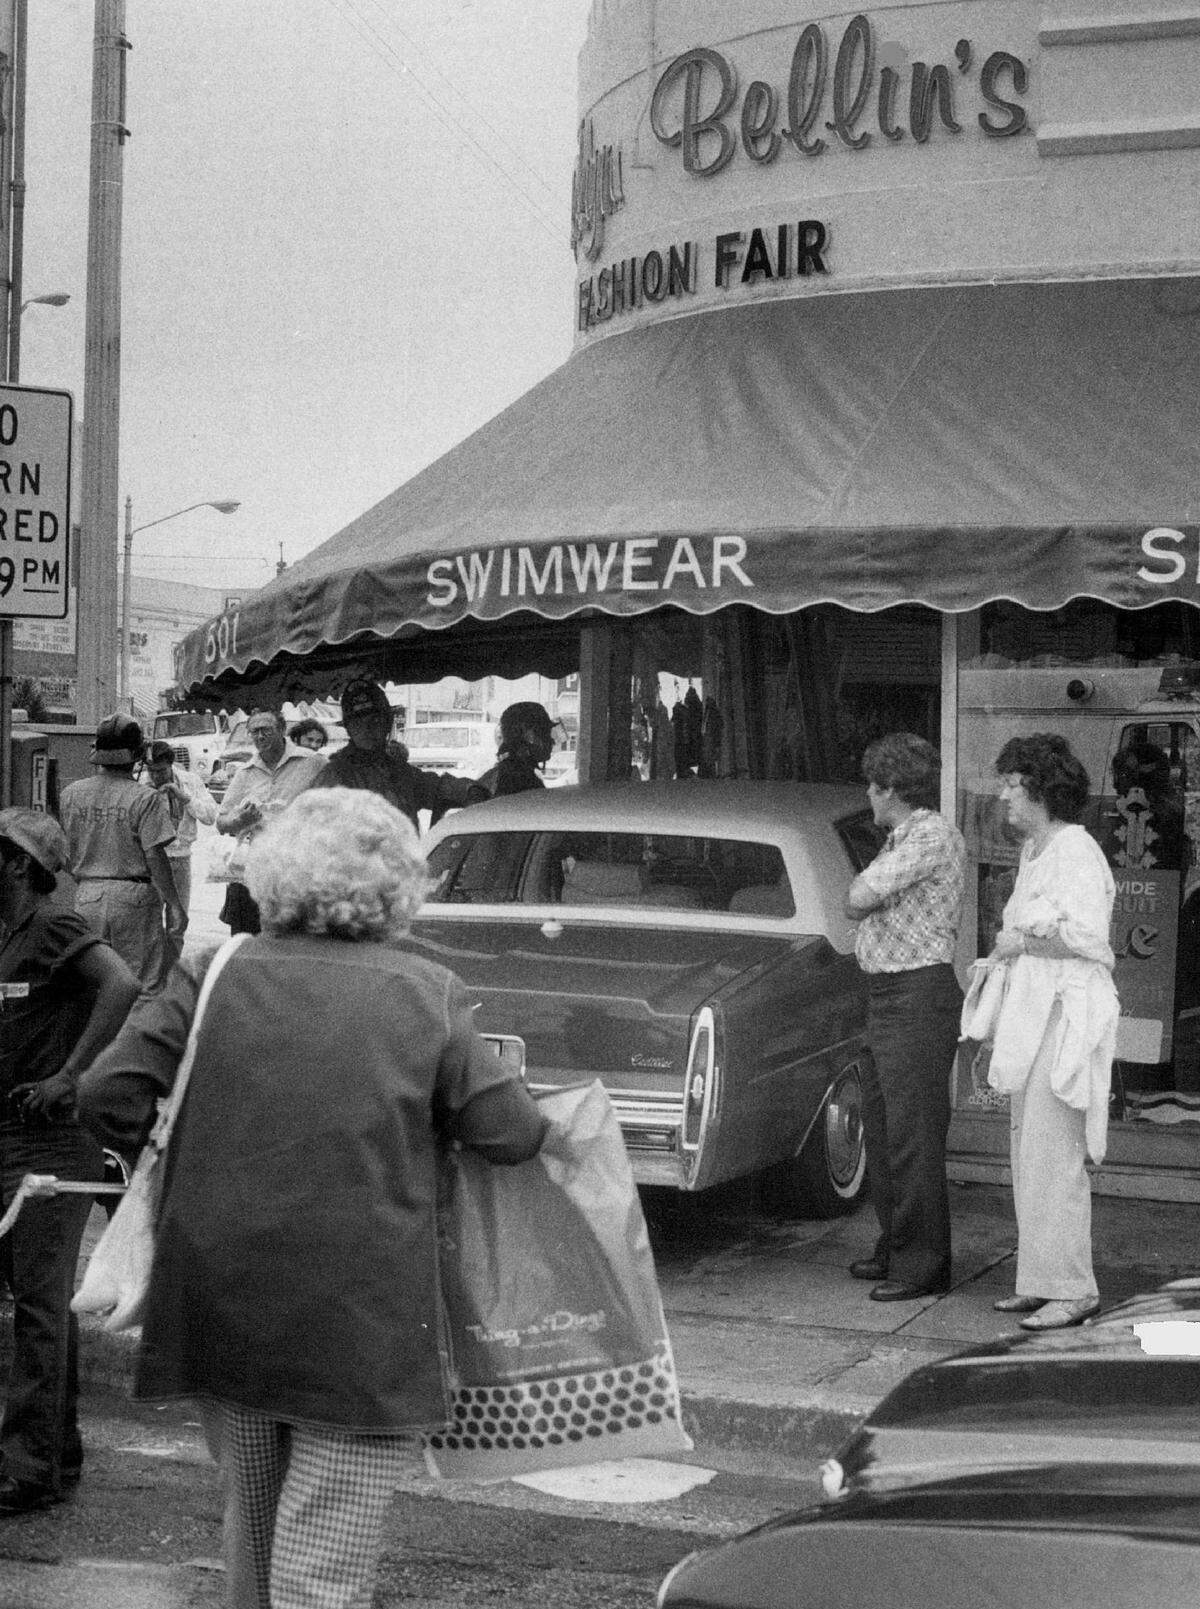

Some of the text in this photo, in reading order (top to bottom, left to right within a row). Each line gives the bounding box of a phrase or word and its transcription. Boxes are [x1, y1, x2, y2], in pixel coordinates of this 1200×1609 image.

[650, 14, 1030, 177] Bellin's
[579, 219, 832, 331] FASHION FAIR
[23, 557, 60, 585] PM
[426, 535, 755, 607] SWIMWEAR
[1137, 526, 1200, 585] S
